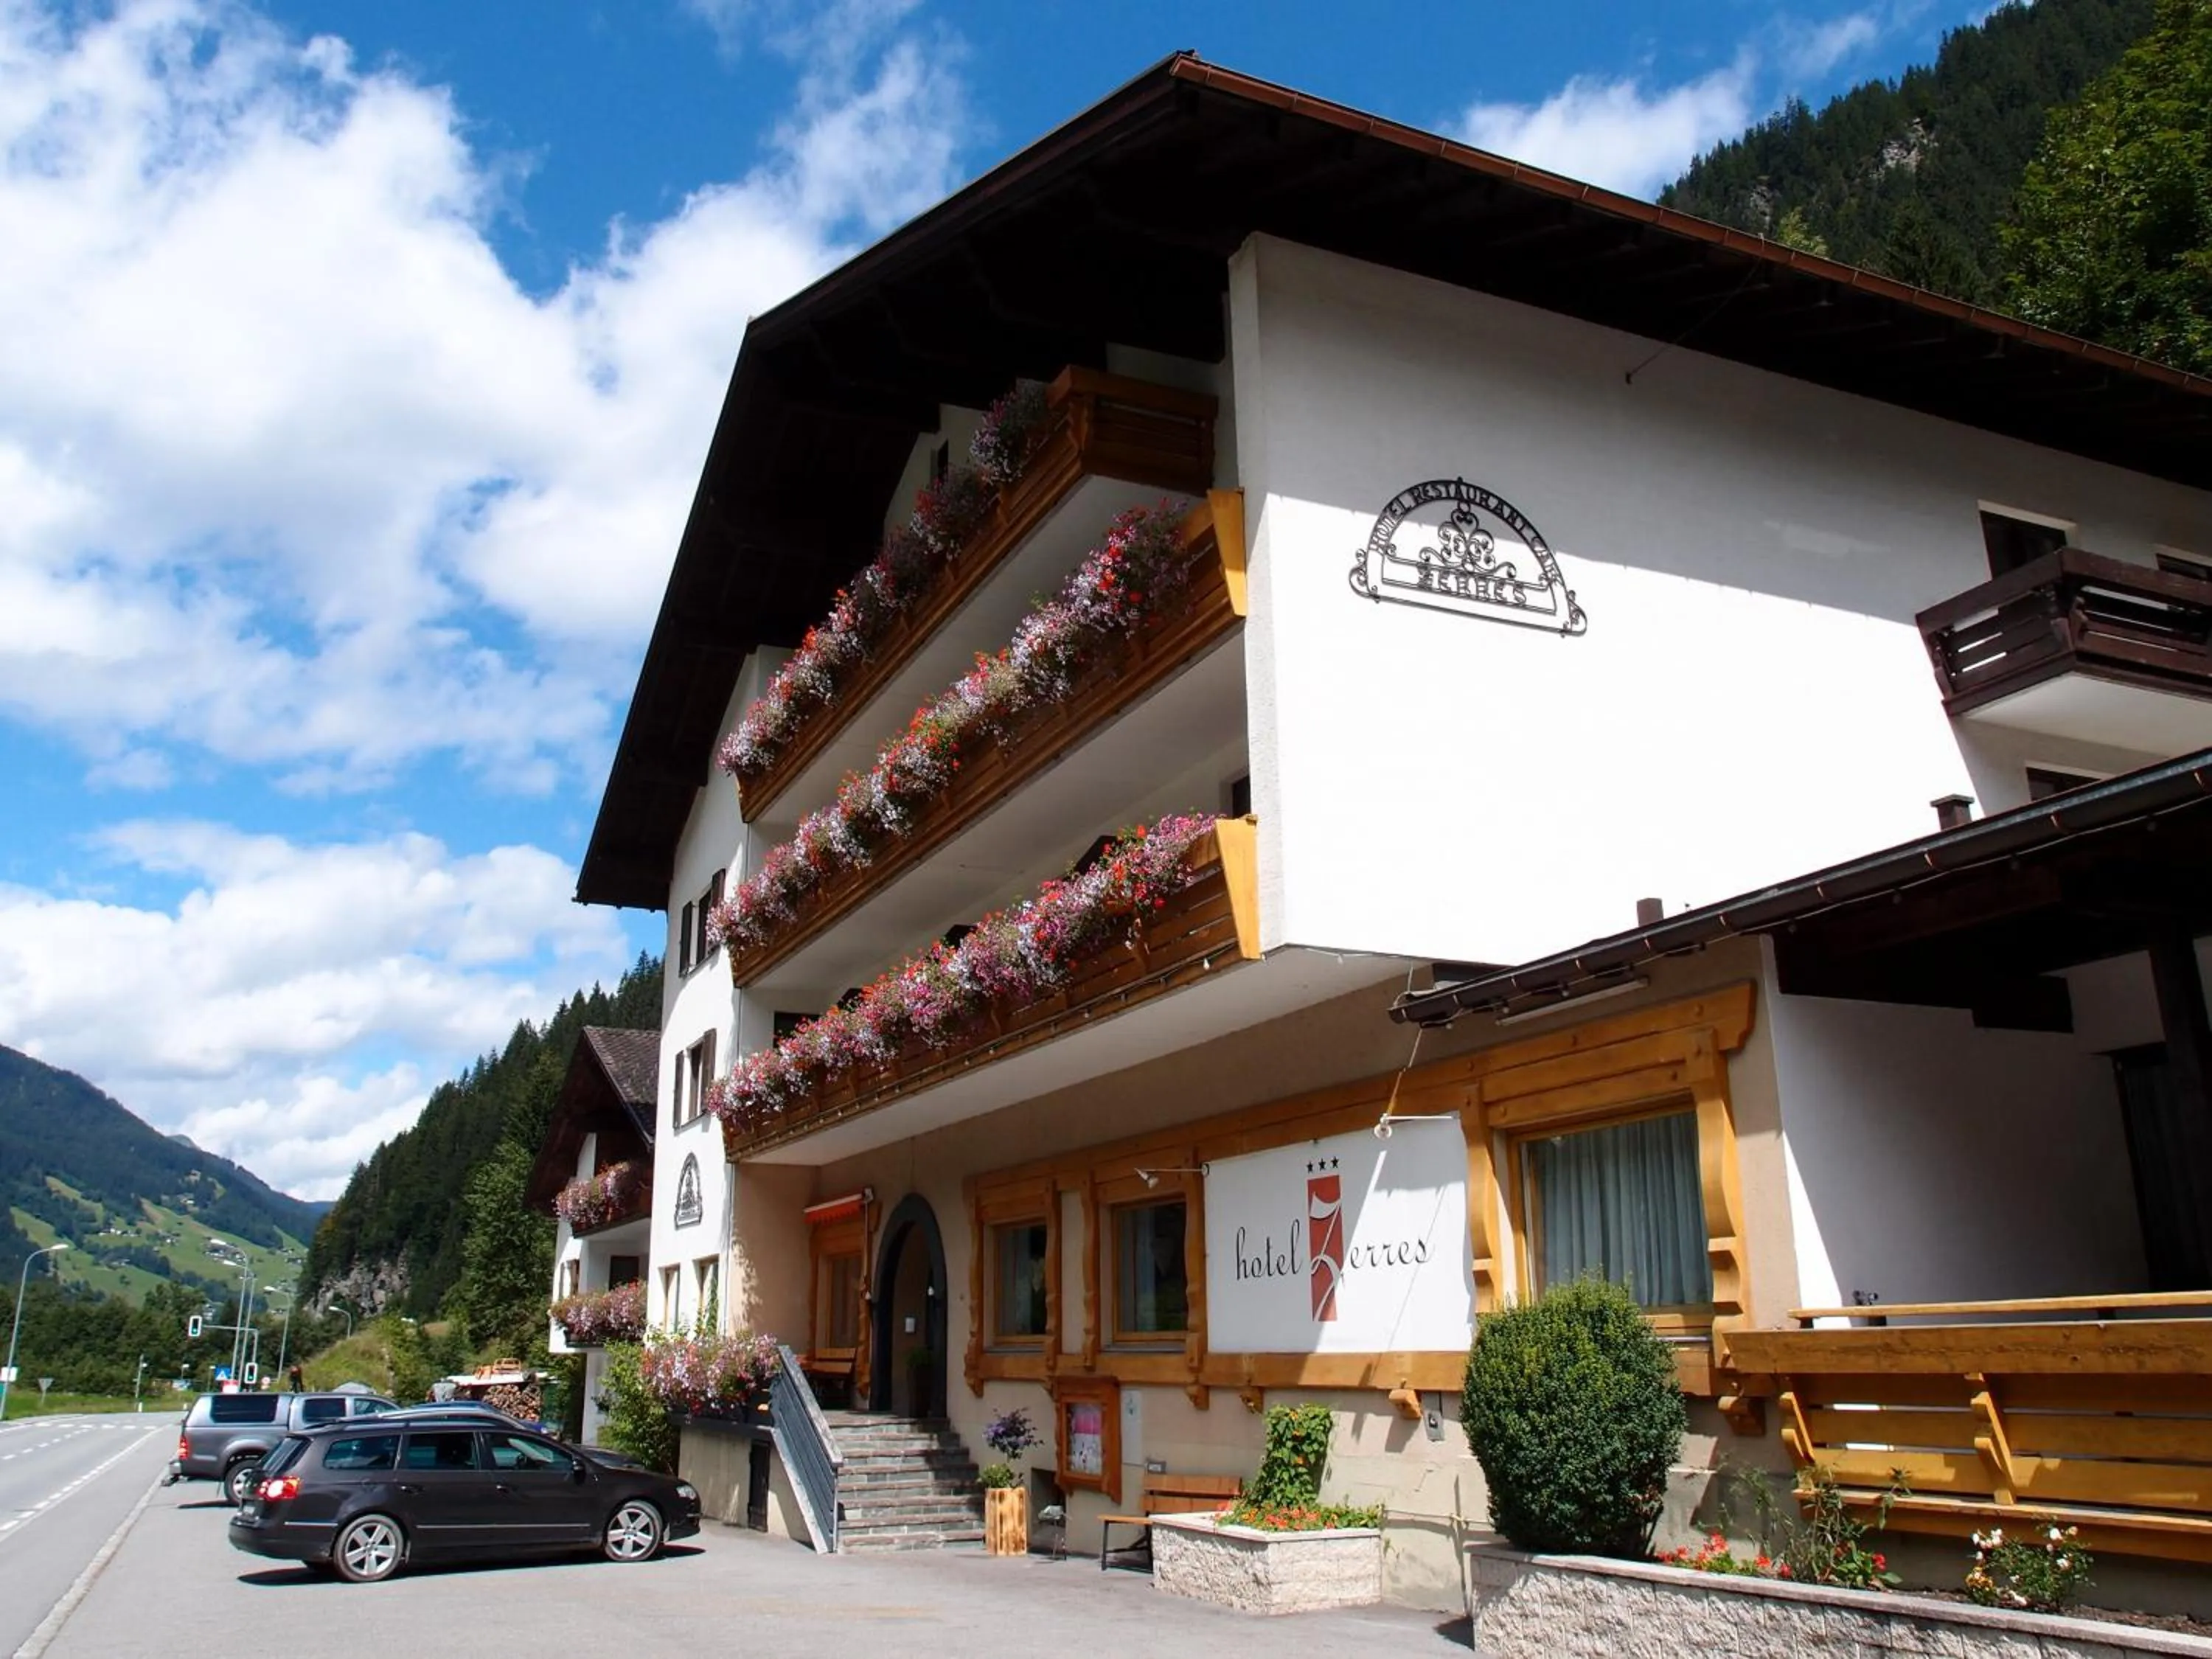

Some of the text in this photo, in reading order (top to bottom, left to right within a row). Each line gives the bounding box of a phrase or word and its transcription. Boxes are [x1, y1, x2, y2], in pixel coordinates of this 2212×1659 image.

[1369, 496, 1417, 553] HOTEL
[1411, 481, 1529, 532] RESTAURANT
[1235, 1219, 1301, 1280] hotel
